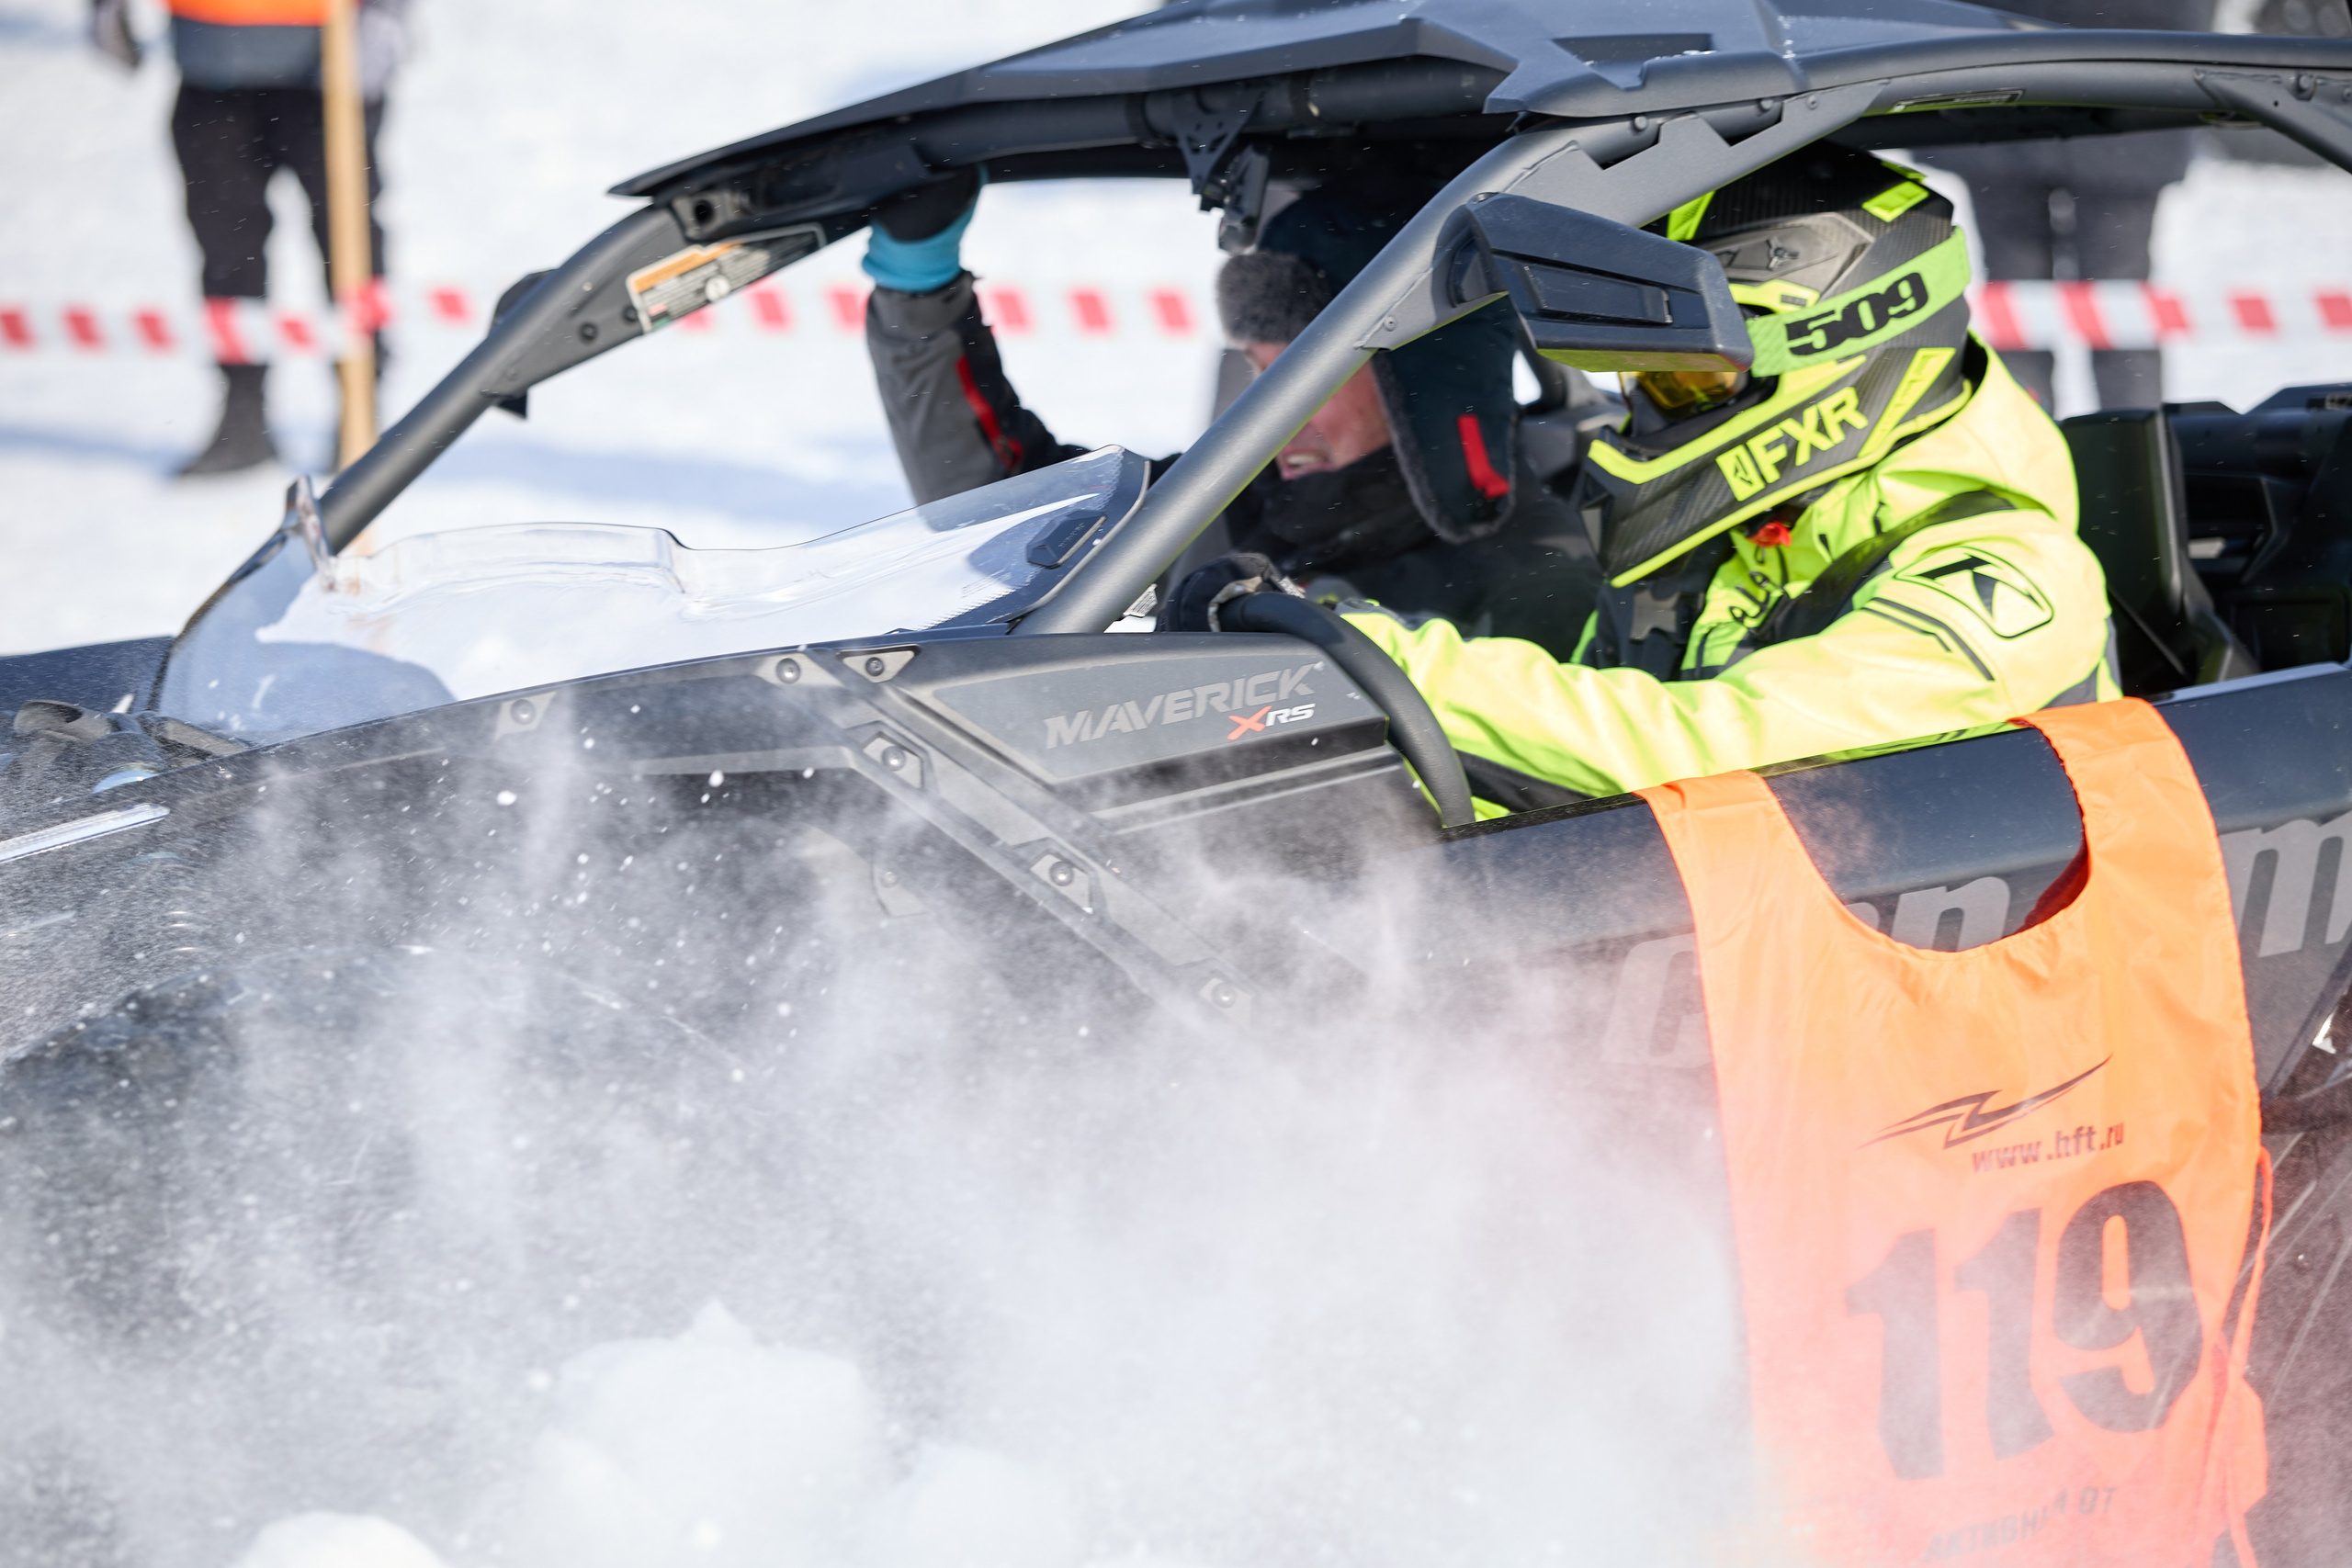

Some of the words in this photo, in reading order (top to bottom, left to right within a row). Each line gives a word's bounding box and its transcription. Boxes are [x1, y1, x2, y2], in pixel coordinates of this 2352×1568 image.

[1784, 272, 1930, 355] 509
[1751, 387, 1869, 483] FXR
[1043, 663, 1316, 750] MAVERICK
[1843, 1179, 2204, 1482] 119
